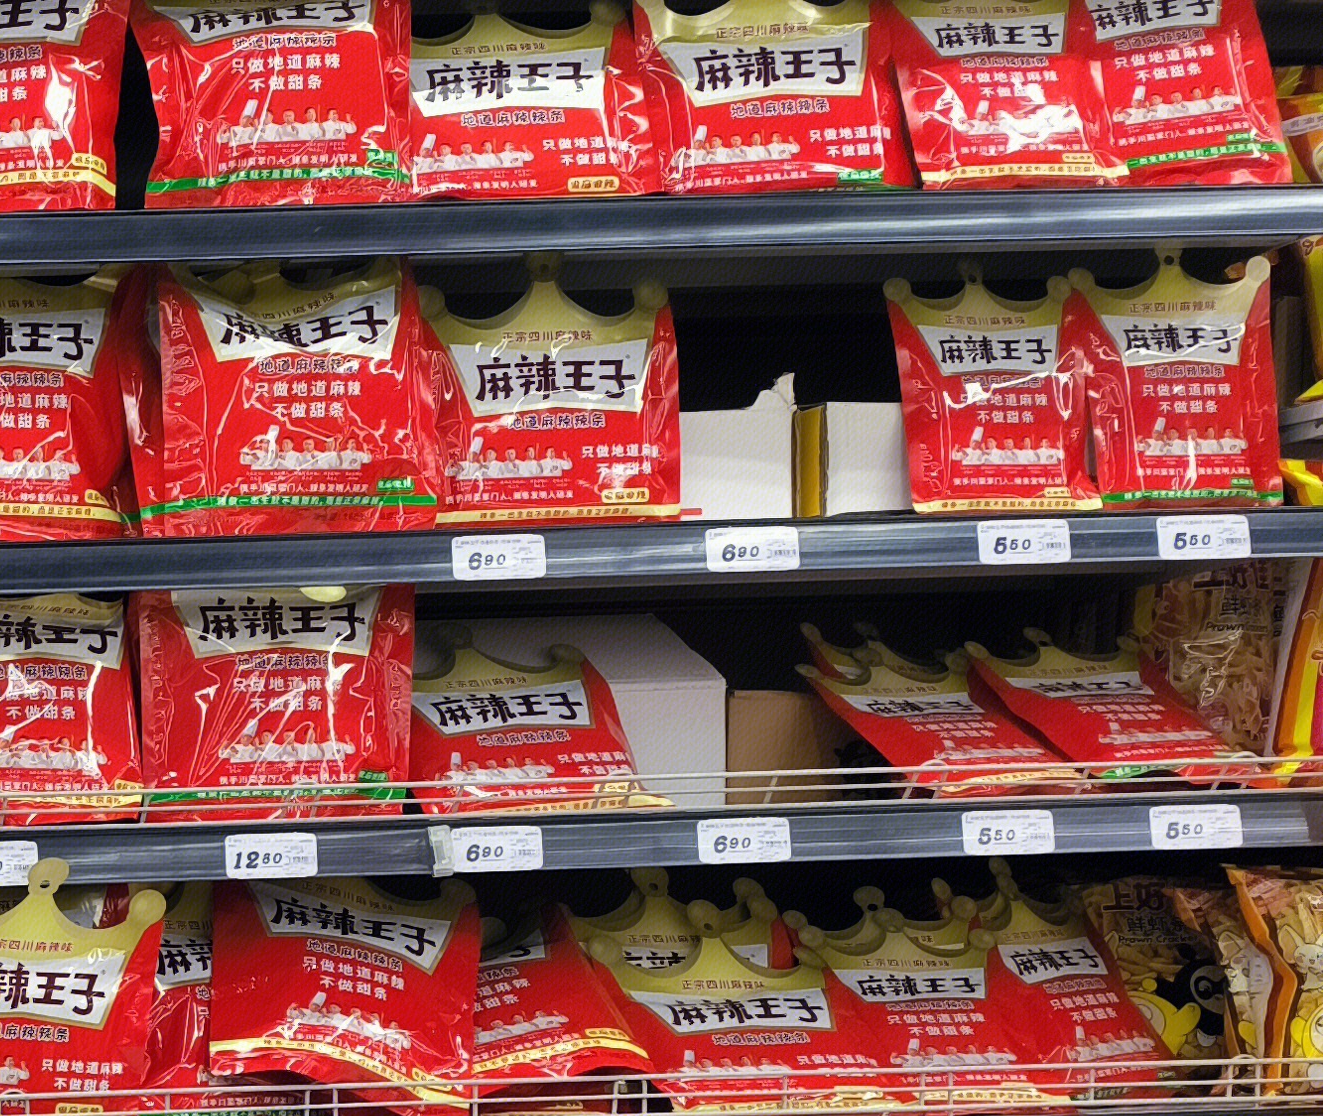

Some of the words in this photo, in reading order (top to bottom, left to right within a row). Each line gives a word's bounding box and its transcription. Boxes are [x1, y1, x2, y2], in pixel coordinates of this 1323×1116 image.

[935, 13, 1062, 53] 麻辣王子
[426, 57, 588, 102] 麻辣王子
[694, 41, 858, 93] 麻辣王子
[939, 329, 1054, 365] 麻辣王子
[476, 349, 639, 404] 麻辣王子
[432, 688, 585, 732] 麻辣王子
[272, 896, 439, 956] 麻辣王子
[1005, 944, 1101, 979] 麻辣王子
[855, 972, 984, 1000] 麻辣王子
[664, 993, 826, 1028] 麻辣王子
